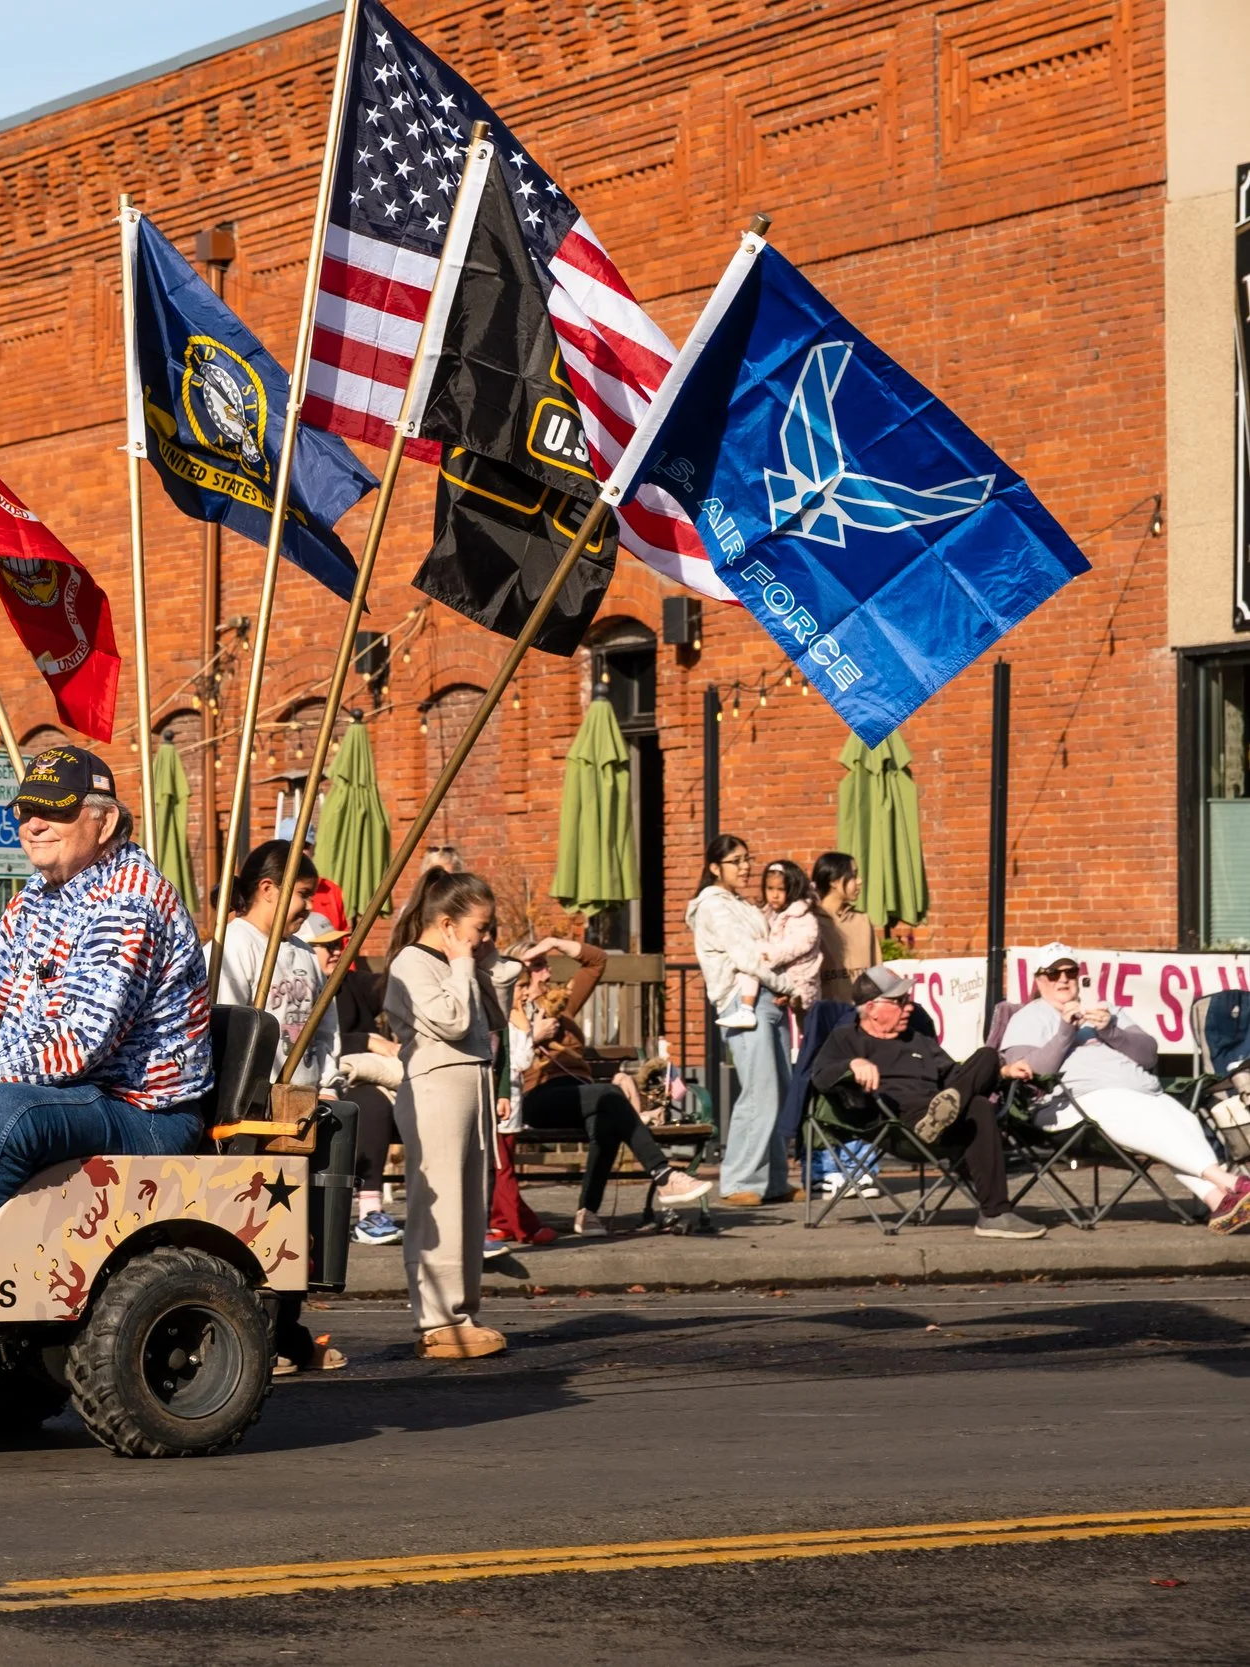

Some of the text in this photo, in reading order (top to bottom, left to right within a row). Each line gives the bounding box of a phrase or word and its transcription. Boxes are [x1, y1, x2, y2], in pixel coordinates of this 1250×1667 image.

[162, 442, 207, 481] UNITED
[212, 472, 258, 501] STATES
[69, 577, 81, 626] STATES
[697, 497, 746, 566] AIR
[740, 560, 863, 692] FORCE
[25, 774, 60, 784] VETERAN
[16, 794, 55, 807] PROUDLY
[950, 970, 984, 997] Plumb
